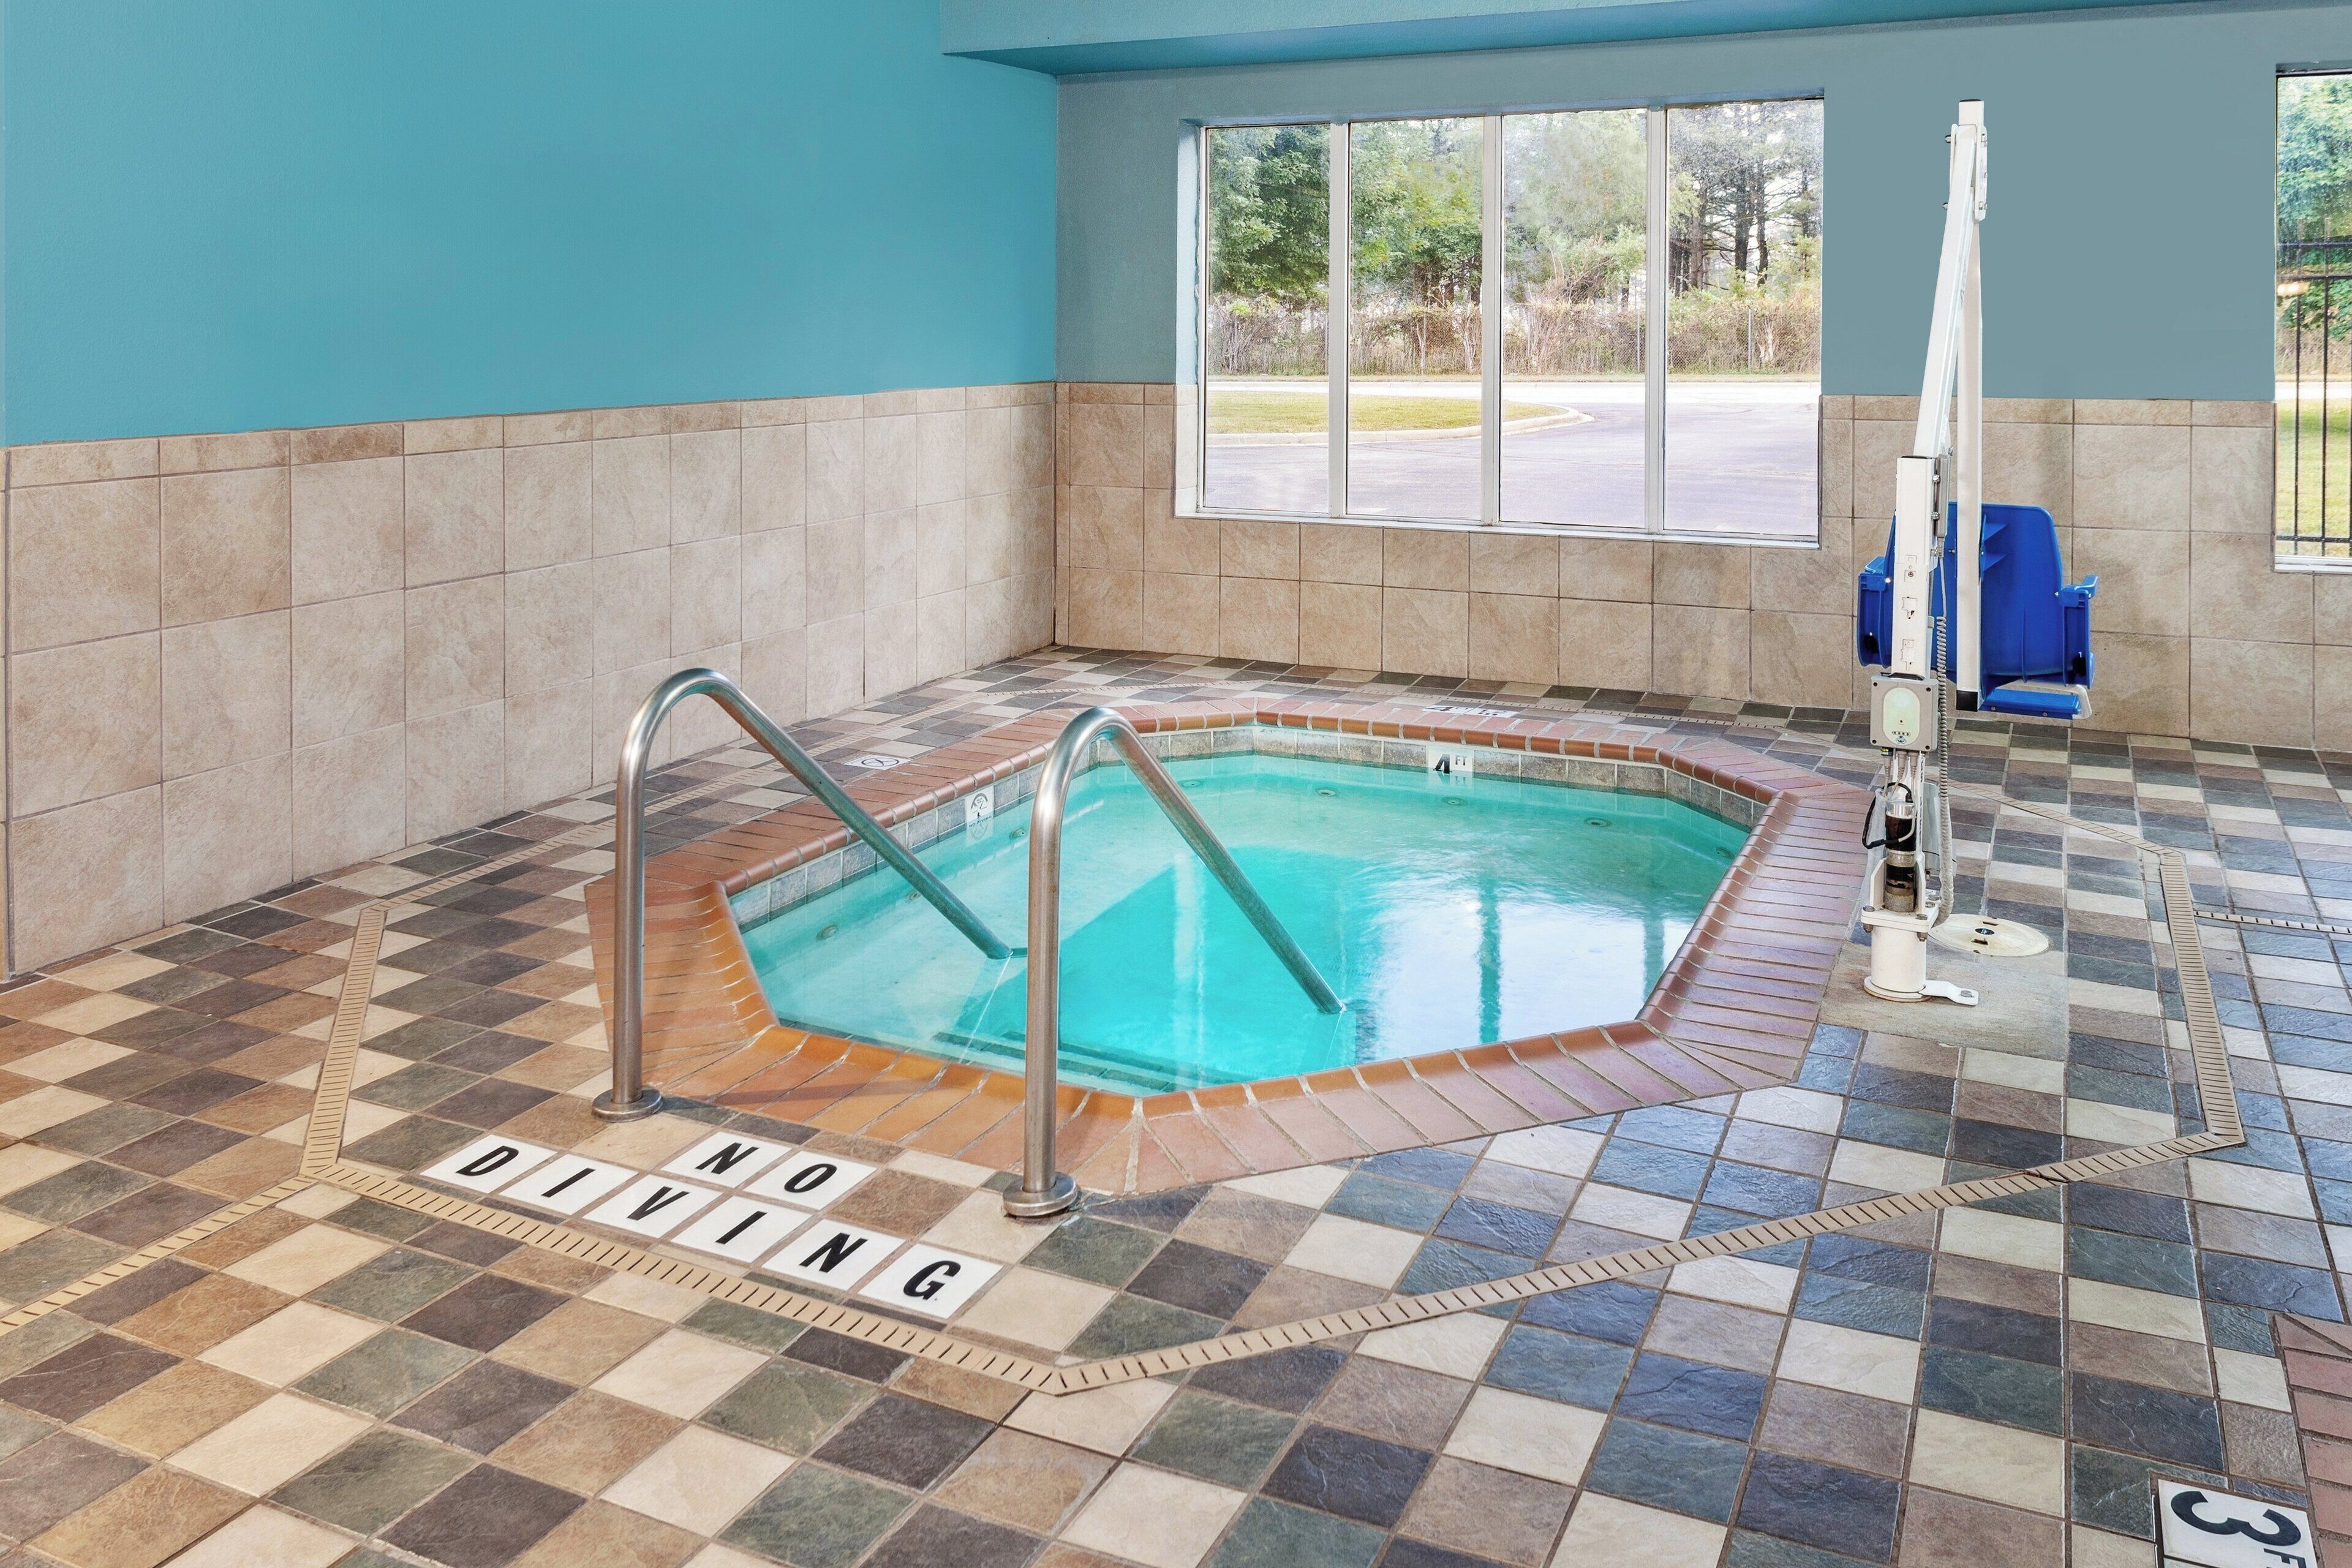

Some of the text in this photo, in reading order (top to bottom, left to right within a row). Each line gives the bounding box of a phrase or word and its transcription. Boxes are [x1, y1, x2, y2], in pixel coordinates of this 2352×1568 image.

[1433, 753, 1468, 774] 4 FT
[976, 815, 992, 824] DIVING
[695, 1142, 837, 1193] NO
[456, 1145, 961, 1300] DIVING
[2170, 1490, 2302, 1547] 3
